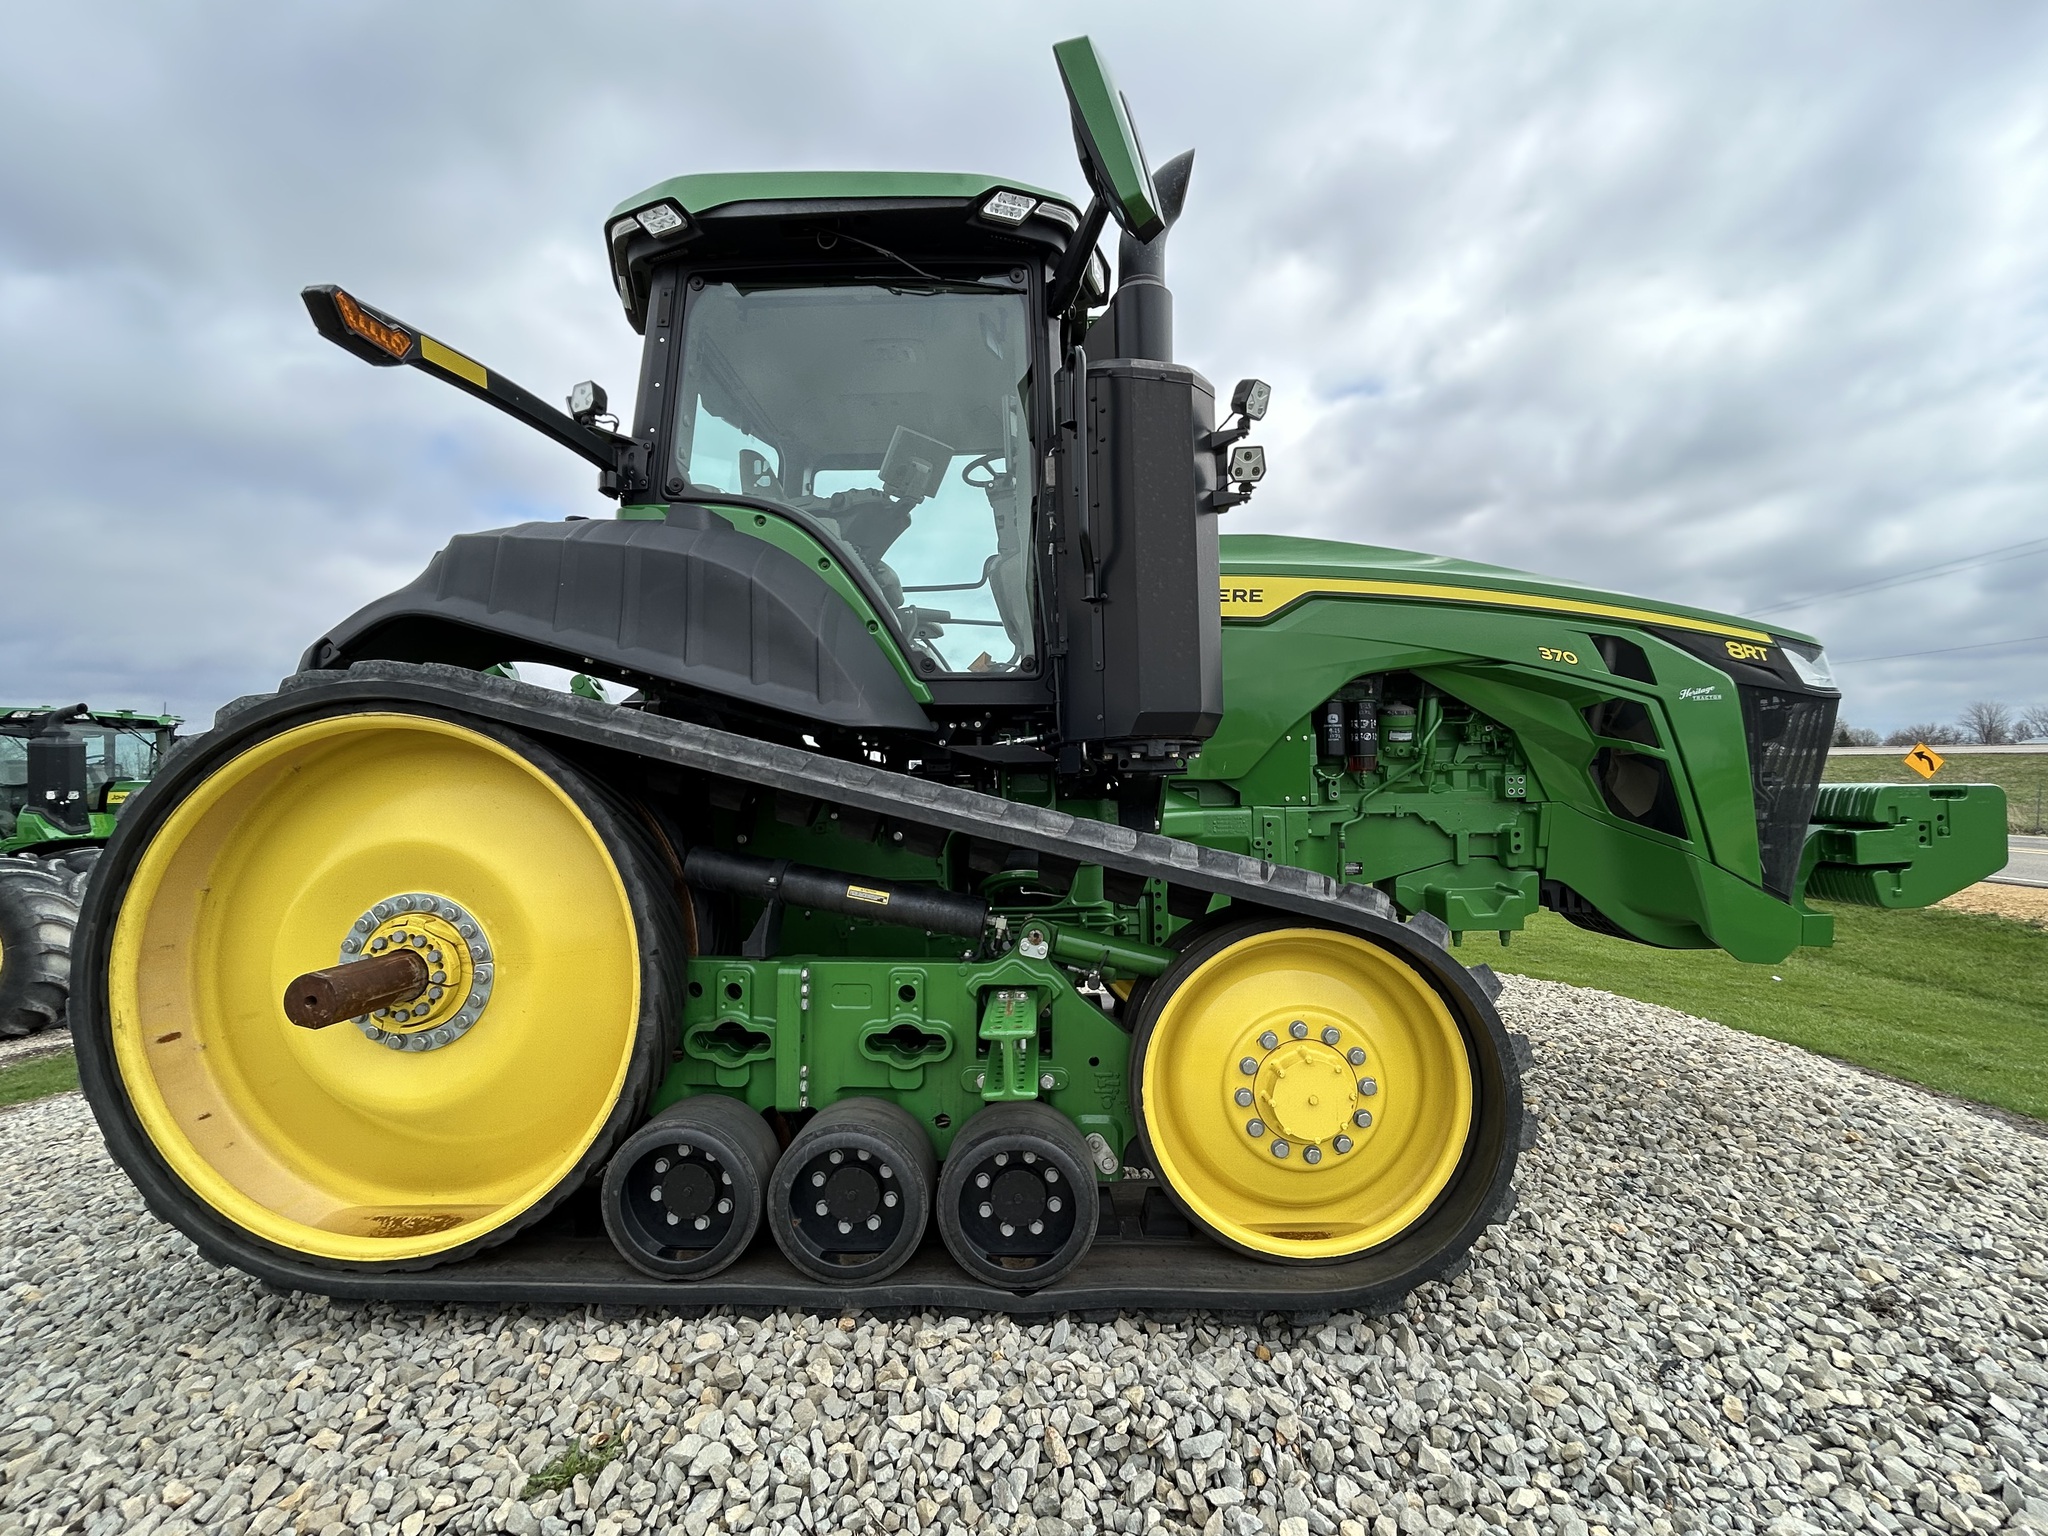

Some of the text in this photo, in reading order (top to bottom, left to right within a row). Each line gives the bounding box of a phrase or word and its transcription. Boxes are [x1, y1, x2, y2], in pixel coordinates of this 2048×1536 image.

[1537, 646, 1578, 665] 370
[1725, 641, 1767, 661] 8RT
[1679, 686, 1715, 700] Heritage
